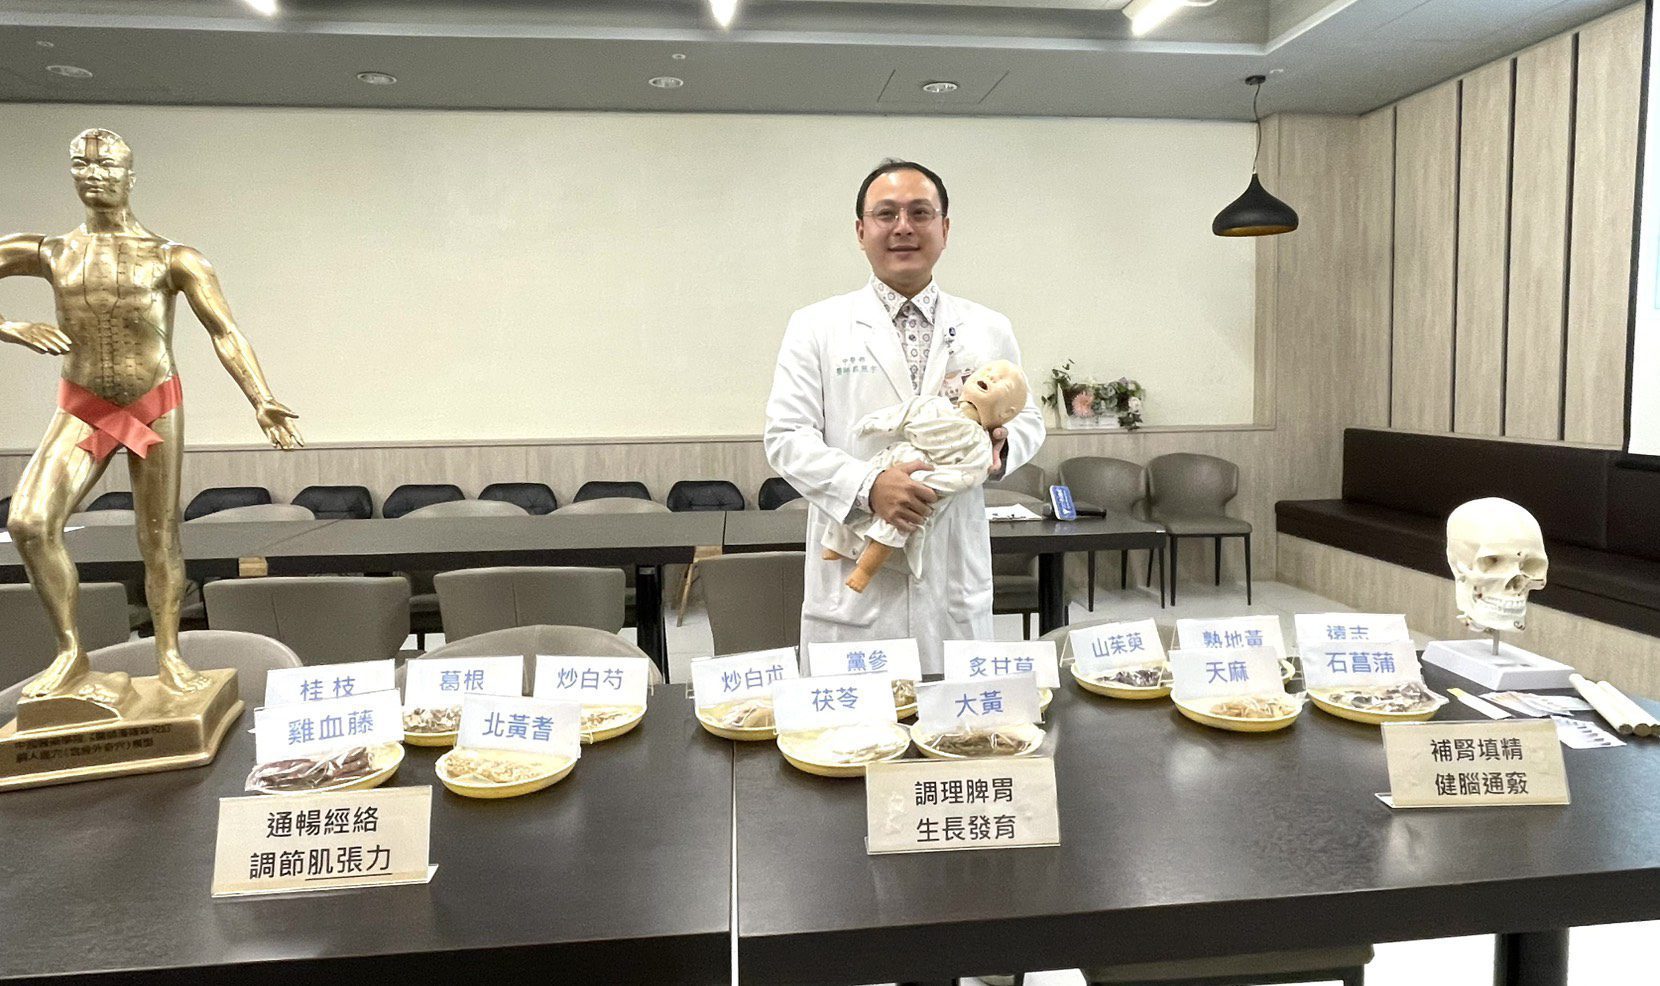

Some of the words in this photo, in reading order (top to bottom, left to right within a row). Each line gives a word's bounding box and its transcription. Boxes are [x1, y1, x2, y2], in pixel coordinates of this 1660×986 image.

[1091, 632, 1146, 658] 山茱萸
[1203, 630, 1264, 649] 熟地黃
[847, 650, 888, 673] 黨參
[969, 657, 1035, 677] 炙甘草
[1205, 661, 1249, 683] 天麻
[1326, 651, 1396, 673] 石菖蒲
[300, 676, 356, 701] 桂枝
[439, 669, 485, 692] 葛根
[557, 668, 624, 691] 炒白芍
[811, 686, 858, 712] 茯苓
[955, 690, 1004, 718] 大黃
[288, 709, 374, 745] 雞血藤
[482, 711, 554, 742] 北黃耆
[1430, 738, 1524, 763] 補腎填精
[915, 777, 1014, 806] 調理脾胃
[1434, 772, 1529, 797] 健腦通竅
[266, 806, 379, 839] 通暢經絡
[916, 814, 1016, 843] 生長發育
[249, 844, 392, 880] 調節肌張力
